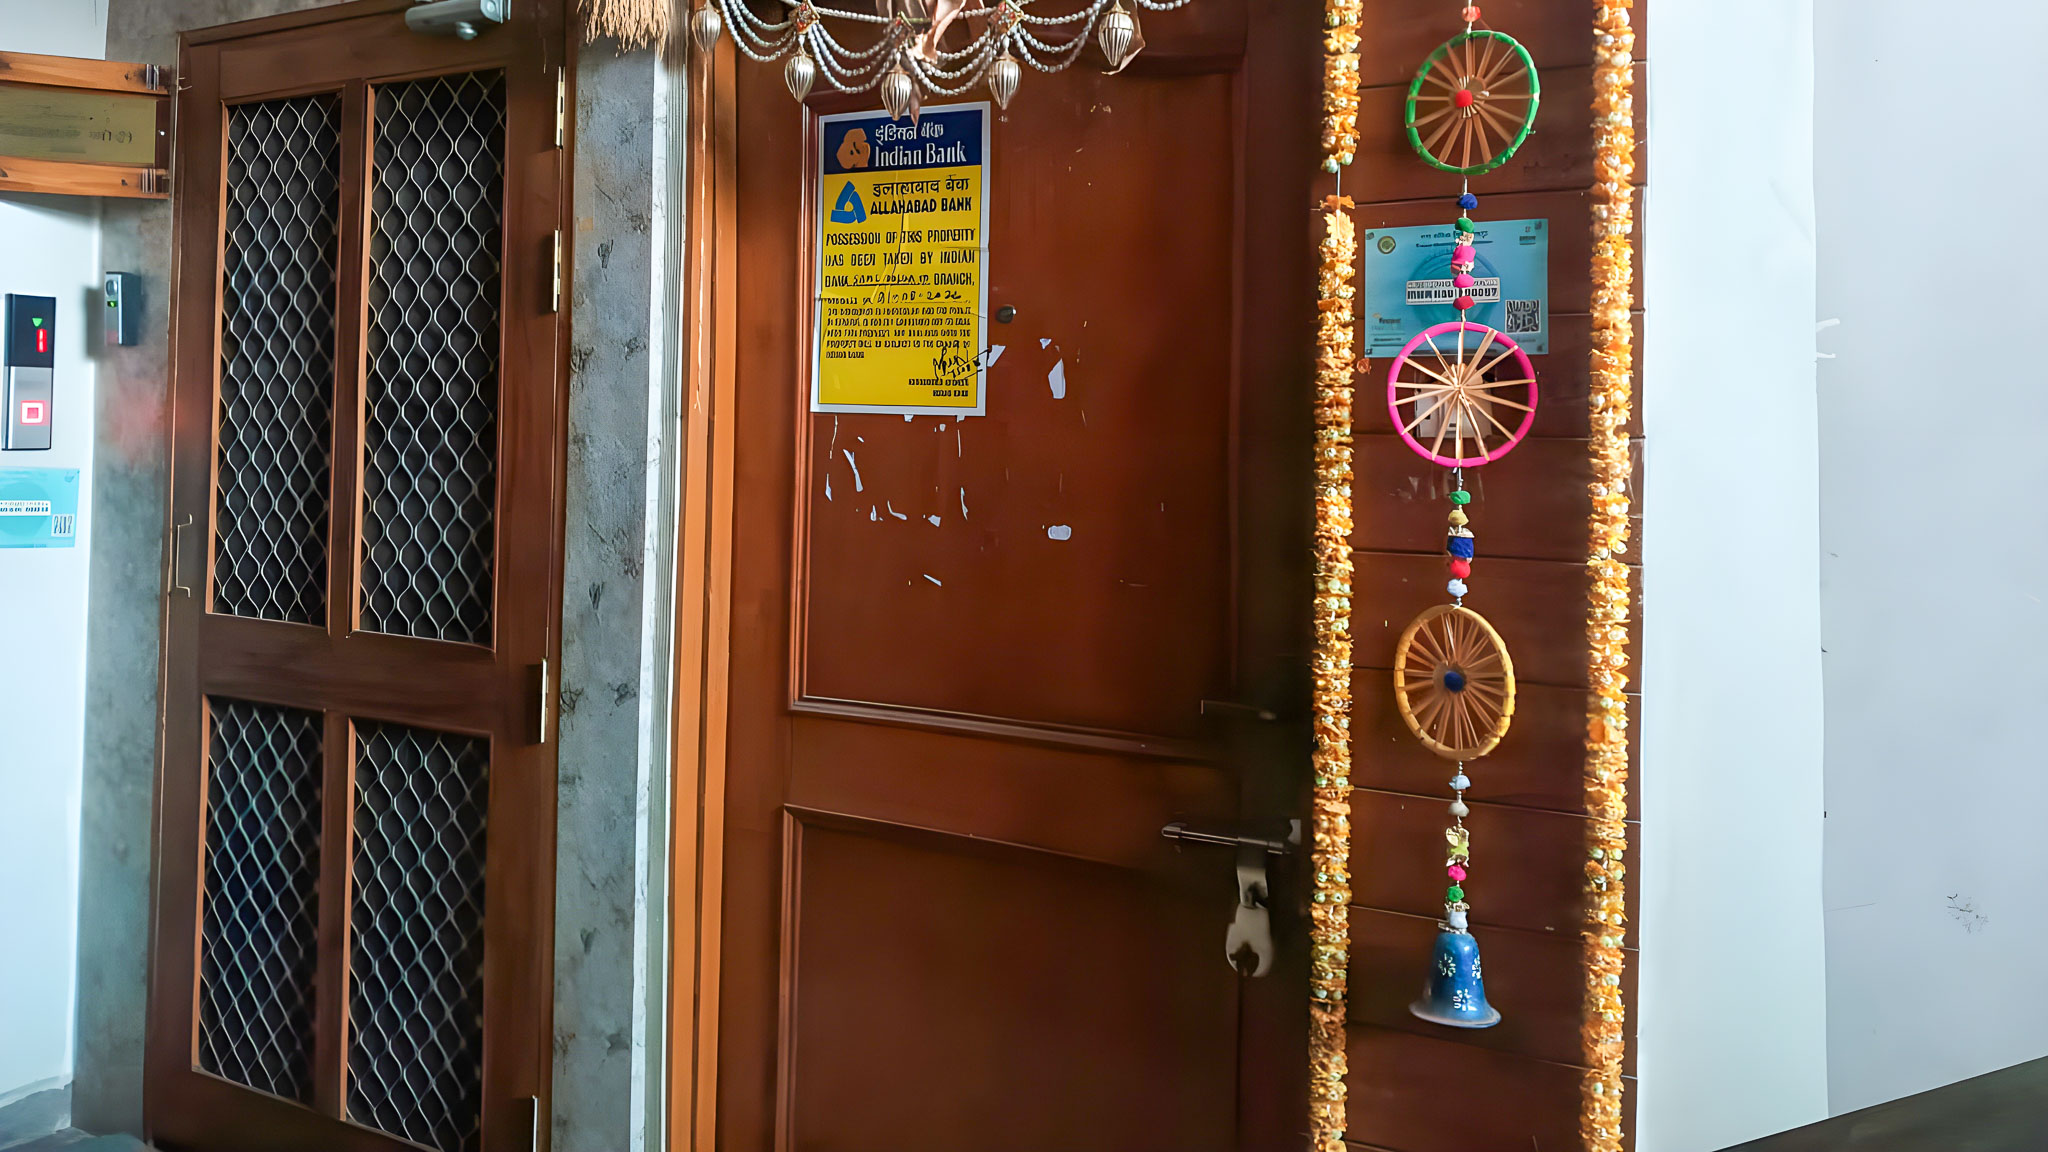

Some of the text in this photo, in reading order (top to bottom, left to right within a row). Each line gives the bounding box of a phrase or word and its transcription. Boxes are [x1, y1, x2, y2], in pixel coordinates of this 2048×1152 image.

[875, 140, 967, 167] Indian Bank
[870, 196, 972, 215] ALLAHABAD BANK
[920, 251, 934, 265] BY
